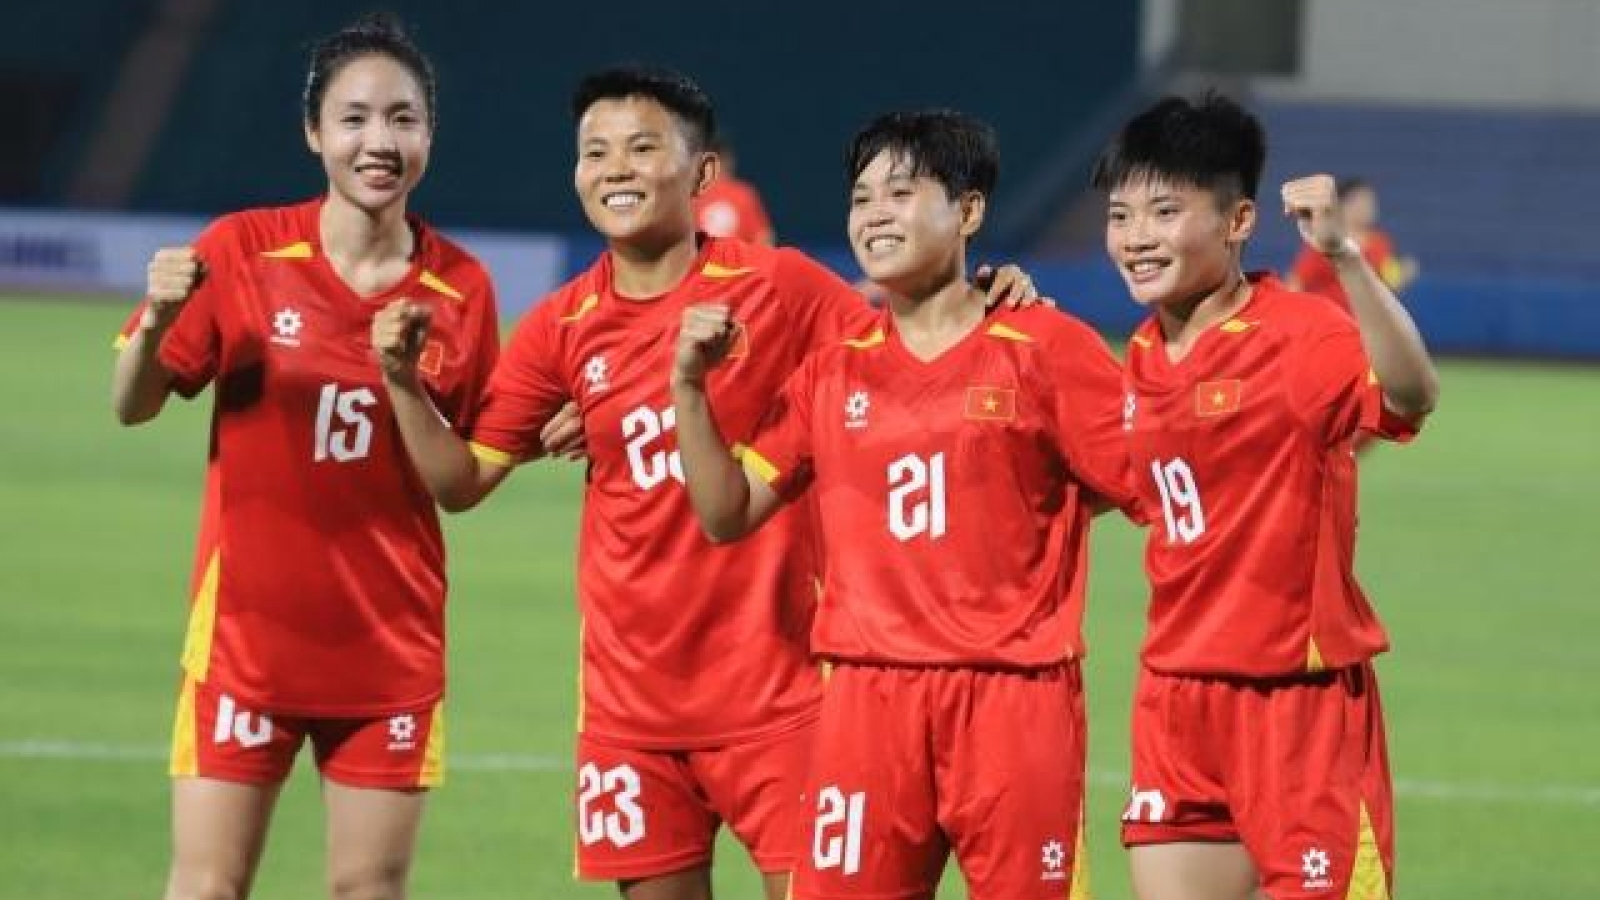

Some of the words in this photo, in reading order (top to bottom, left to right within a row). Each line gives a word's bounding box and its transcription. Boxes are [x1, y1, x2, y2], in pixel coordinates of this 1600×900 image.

[314, 382, 377, 462] 15
[887, 452, 946, 541] 21
[1151, 457, 1206, 543] 19
[579, 762, 645, 848] 23
[812, 786, 866, 875] 21
